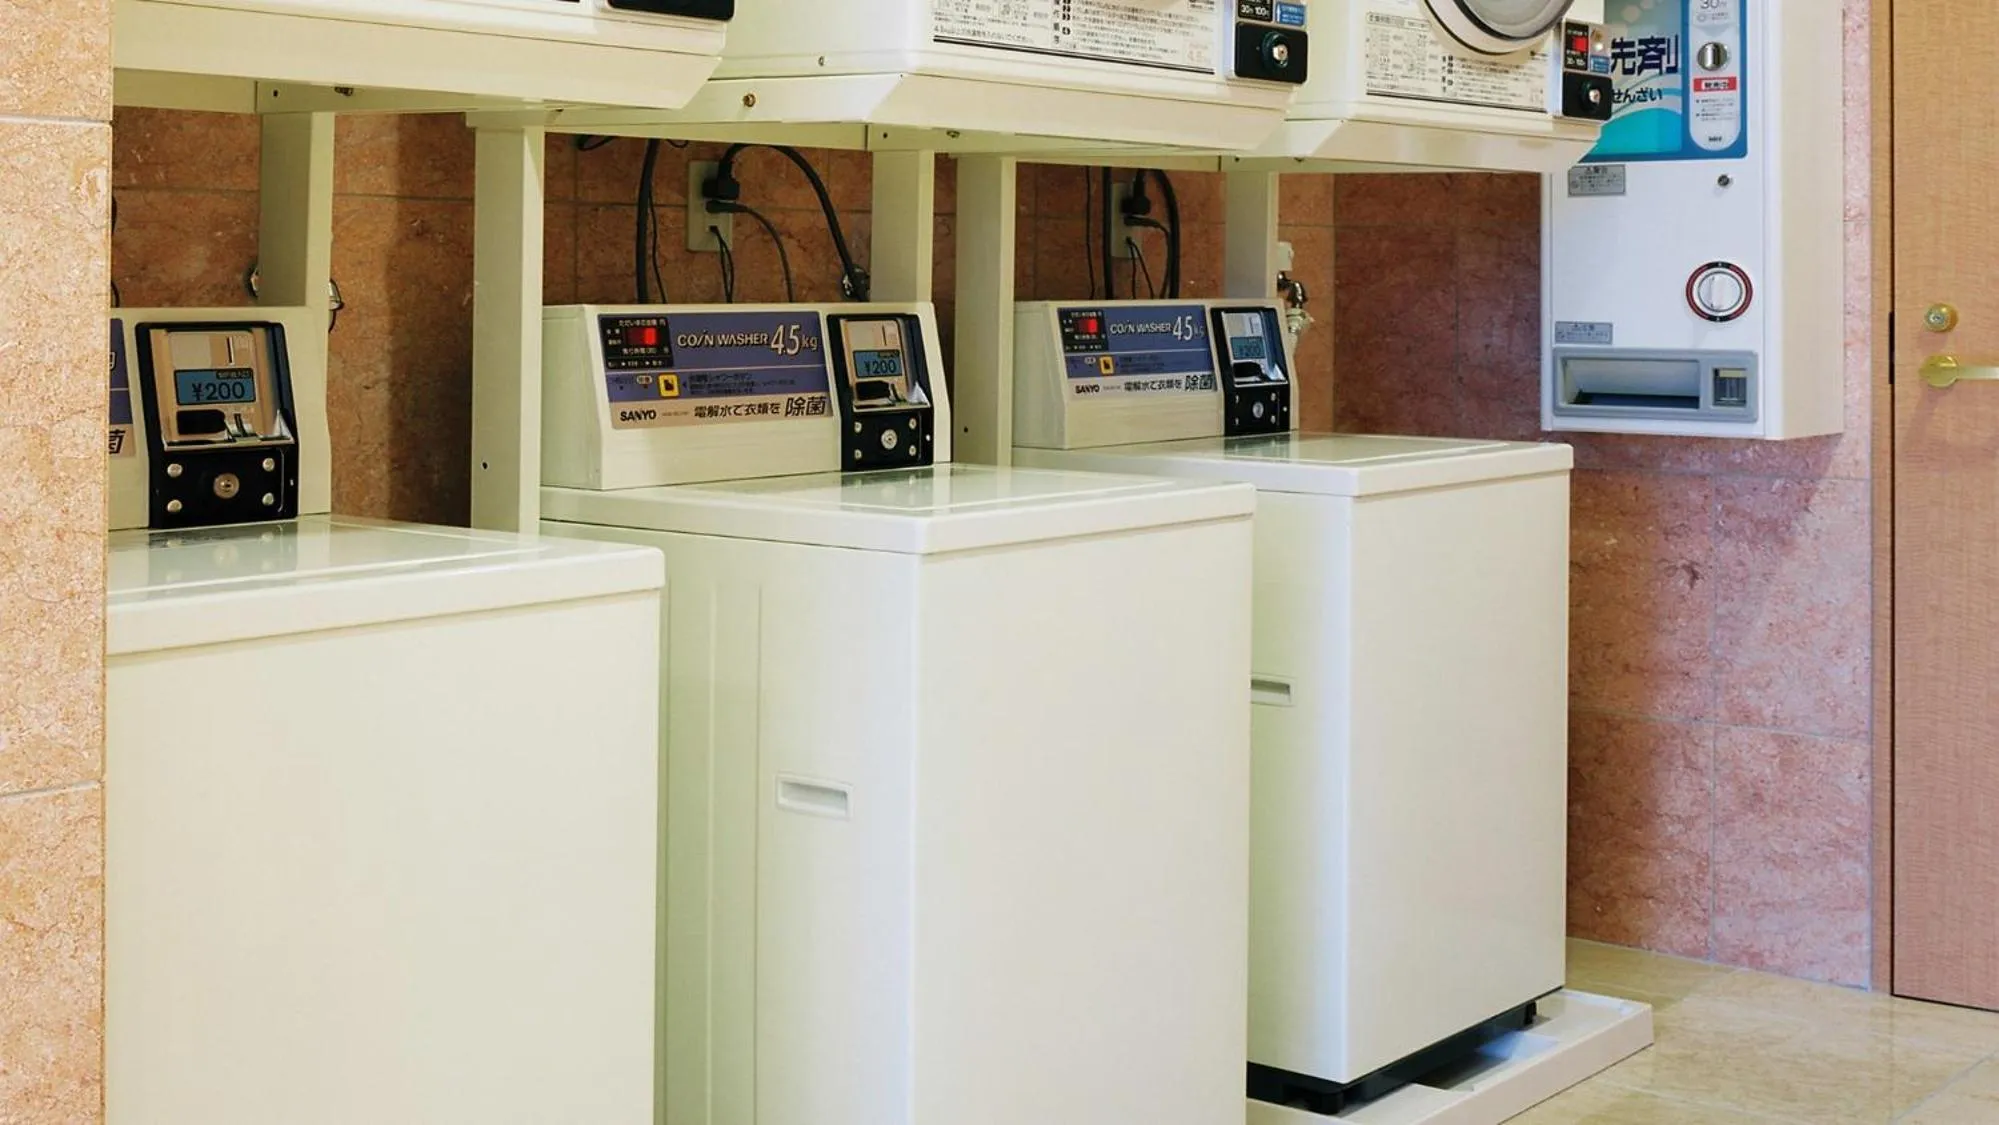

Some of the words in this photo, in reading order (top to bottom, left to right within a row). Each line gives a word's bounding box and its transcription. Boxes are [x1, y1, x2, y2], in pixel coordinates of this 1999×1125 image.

[1109, 319, 1136, 335] COIN
[1136, 322, 1173, 335] WASHER
[677, 330, 714, 347] COIN
[717, 333, 770, 347] WASHER
[864, 359, 897, 376] ¥200
[191, 382, 246, 401] ¥200
[1075, 384, 1101, 394] SANYO
[620, 409, 657, 422] SANYO
